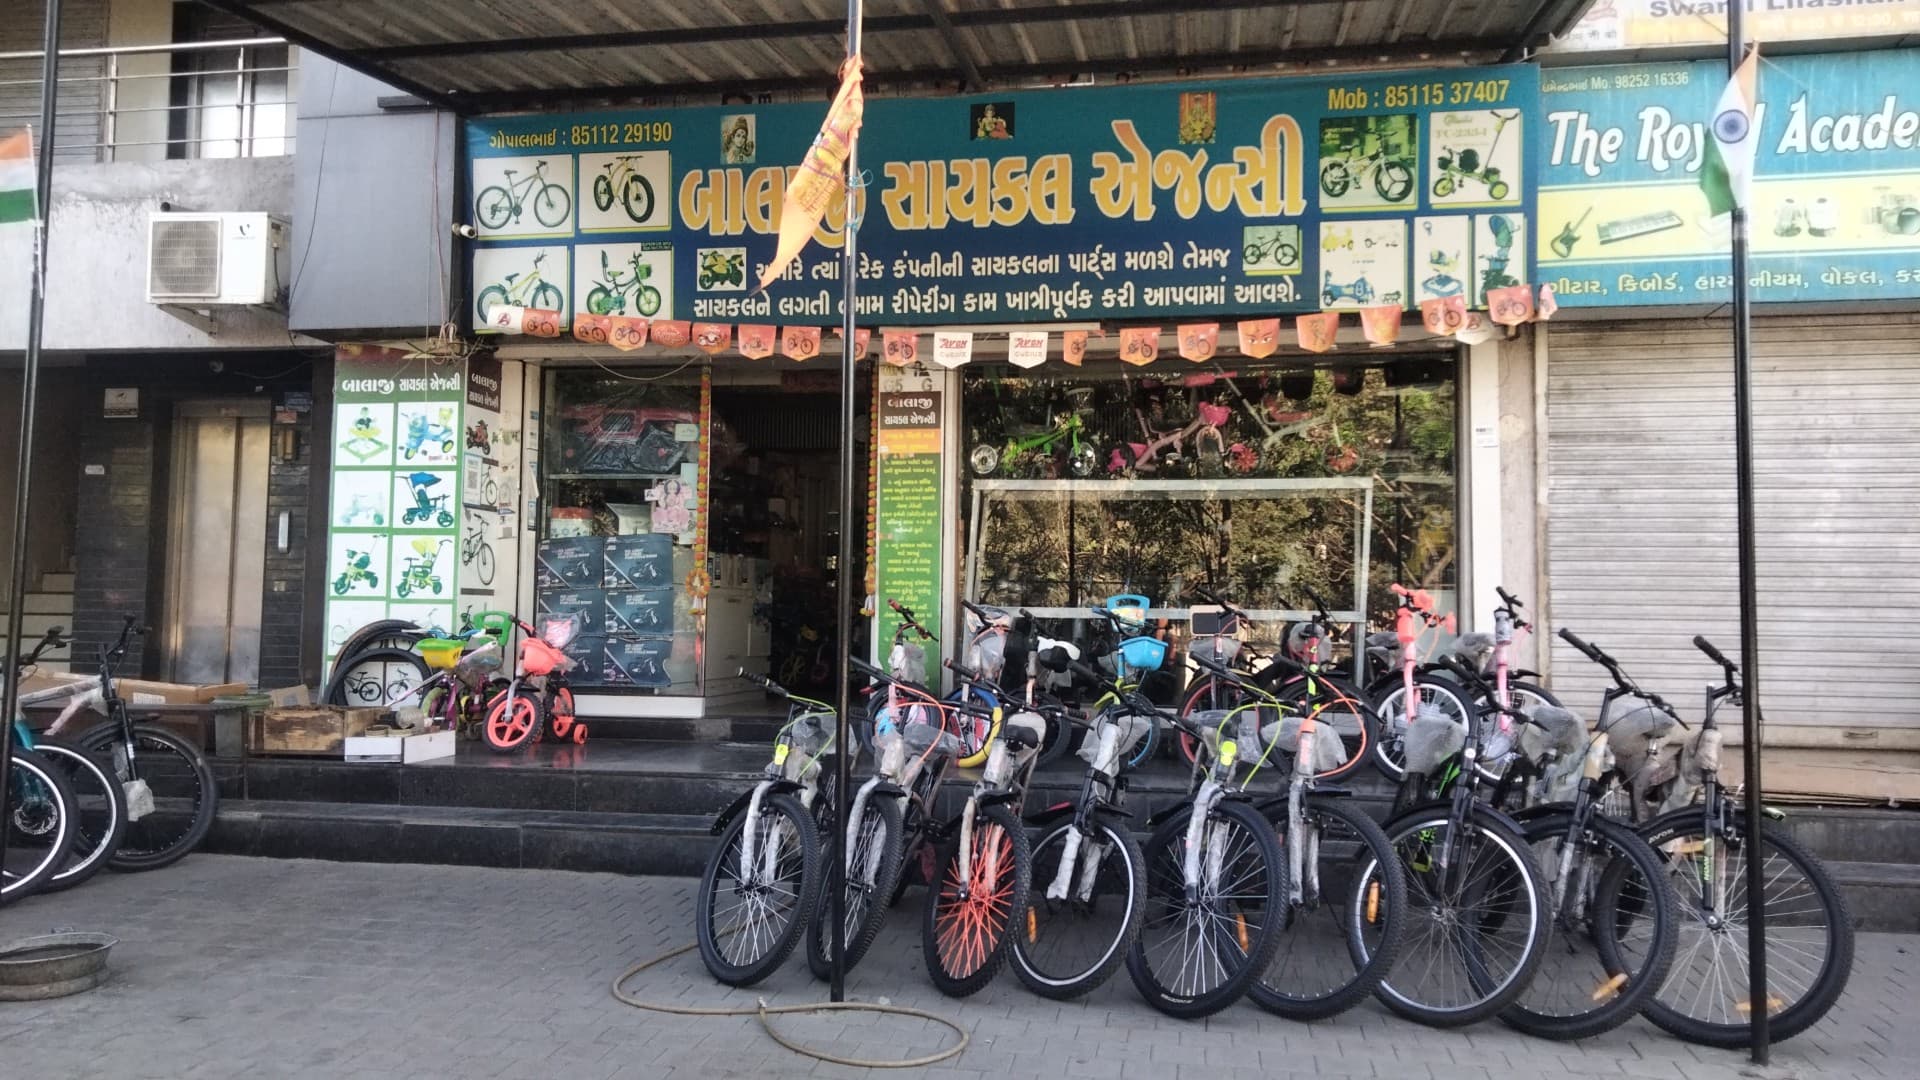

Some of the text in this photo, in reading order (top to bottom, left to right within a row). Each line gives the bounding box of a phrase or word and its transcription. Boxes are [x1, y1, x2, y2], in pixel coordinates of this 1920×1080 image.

[1328, 87, 1368, 110] Mob
[1385, 82, 1444, 107] 85115
[1451, 79, 1510, 104] 37407
[1591, 77, 1612, 91] Mo.
[1615, 74, 1650, 89] 98252
[1654, 71, 1689, 86] 16336
[489, 128, 558, 149] ગોપાલભાઈ
[571, 124, 619, 145] 85112
[624, 122, 672, 143] 29190
[1547, 91, 1920, 176] The Royl Acade
[678, 166, 867, 249] બાલજી
[881, 153, 1077, 231] સાયકલ
[1090, 113, 1307, 222] એજન્સી
[811, 251, 839, 281] ત્યાં
[853, 252, 885, 280] રેક
[892, 249, 964, 279] કંપનીની
[971, 253, 1060, 277] સાયકલના
[1068, 243, 1117, 280] પાર્ટ્સ
[1124, 241, 1174, 271] મળશે
[1182, 240, 1231, 269] તેમજ
[1820, 266, 1884, 287] વોકલ,
[693, 289, 771, 318] સાયકલને
[778, 289, 830, 316] લગતી
[891, 285, 956, 314] રીપેરીંગ
[963, 292, 997, 312] કામ
[1005, 281, 1094, 319] ખાત્રીપૂર્વક
[1101, 280, 1135, 308] કરી
[1143, 275, 1226, 307] આપવામાં
[1234, 275, 1301, 304] આવશે.
[341, 371, 461, 395] બાલાજી સાયકલ એજન્સી
[471, 372, 498, 392] બાલાજી
[887, 398, 933, 409] બાલાજી
